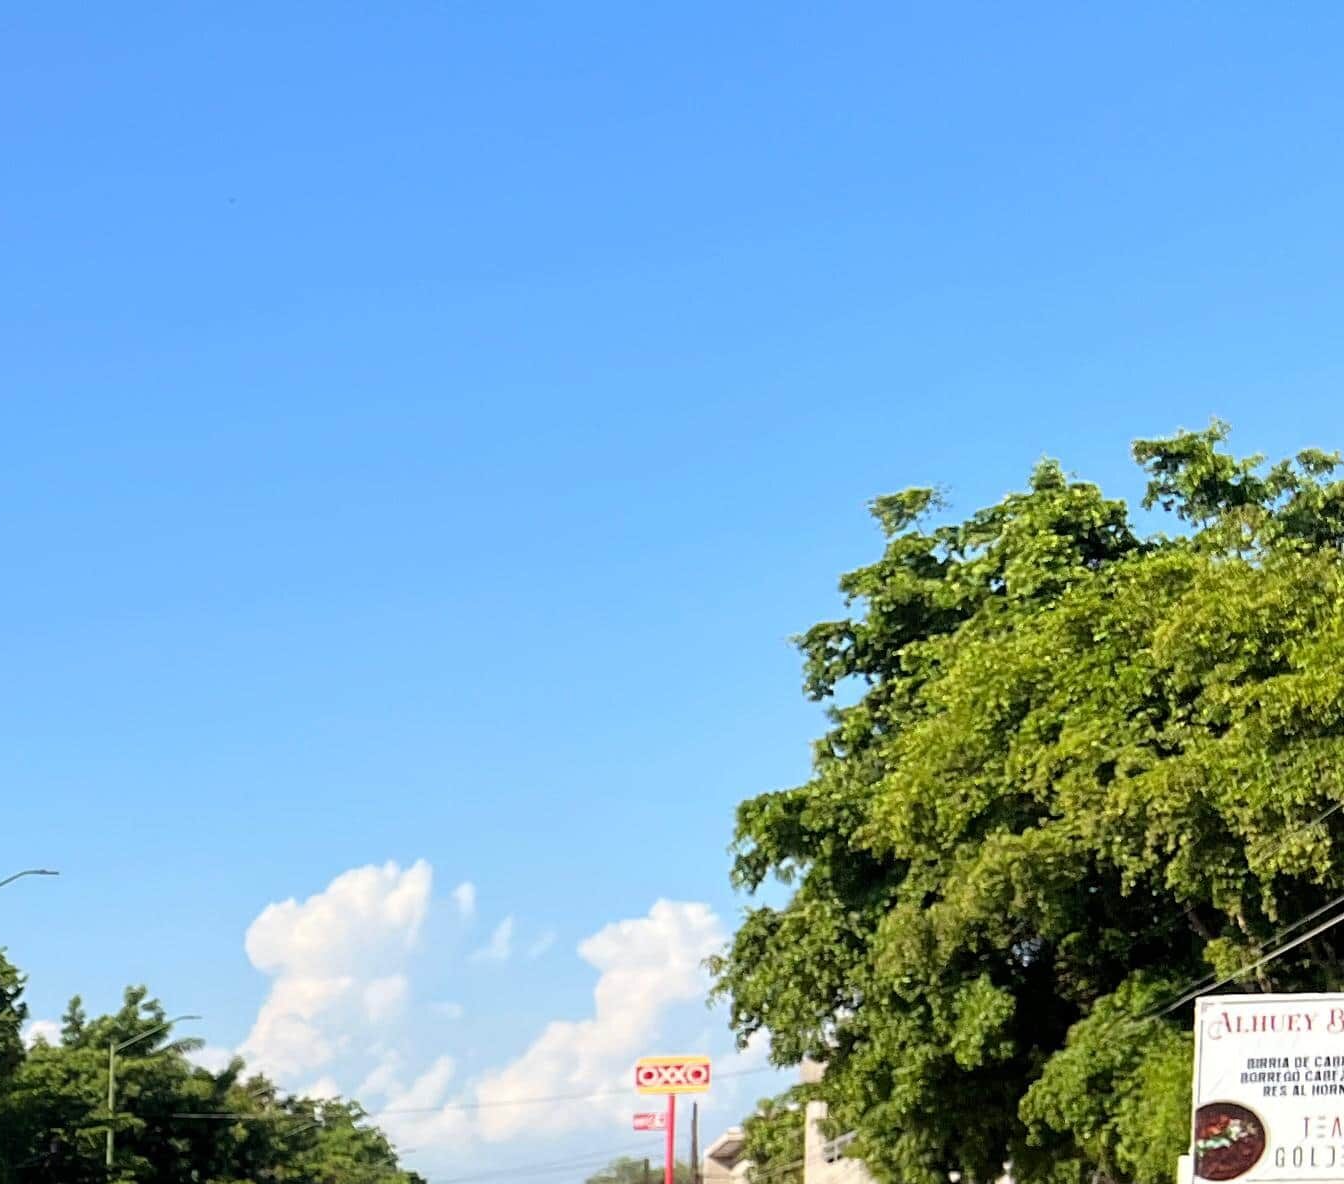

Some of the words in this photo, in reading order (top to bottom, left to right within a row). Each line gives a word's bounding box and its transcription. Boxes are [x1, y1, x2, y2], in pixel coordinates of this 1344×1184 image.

[1208, 1011, 1316, 1040] ALHUEY
[1247, 1057, 1289, 1069] BIRRIA
[1294, 1056, 1310, 1068] DE
[639, 1065, 706, 1087] OXXO
[1240, 1070, 1300, 1084] BORREGO
[1263, 1085, 1287, 1097] RES
[1292, 1084, 1306, 1096] AL
